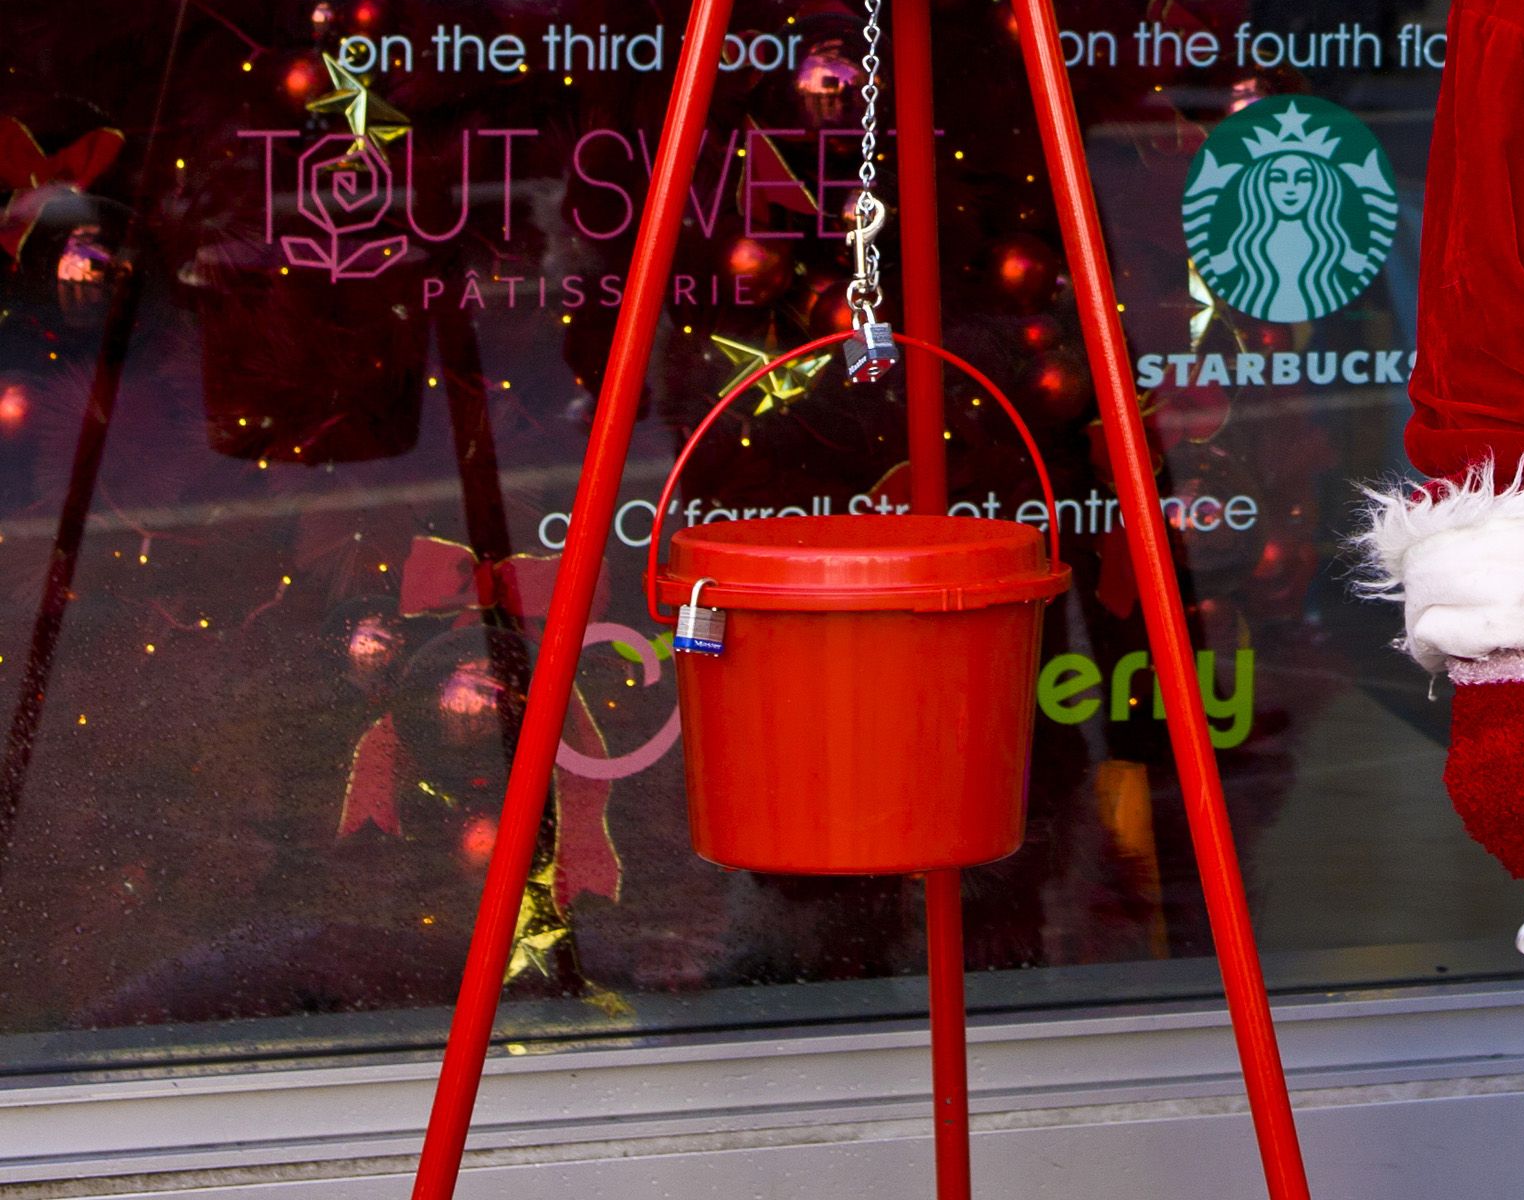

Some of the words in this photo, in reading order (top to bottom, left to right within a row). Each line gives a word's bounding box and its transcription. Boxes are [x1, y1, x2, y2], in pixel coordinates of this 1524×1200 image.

[340, 34, 412, 72] on
[432, 24, 525, 72] the
[543, 24, 663, 72] third
[682, 33, 802, 71] oor
[1060, 29, 1118, 67] on
[1134, 22, 1220, 68] the
[1235, 22, 1381, 68] fourth
[423, 271, 755, 309] PÂTISSRIE
[1015, 490, 1258, 534] entrnce
